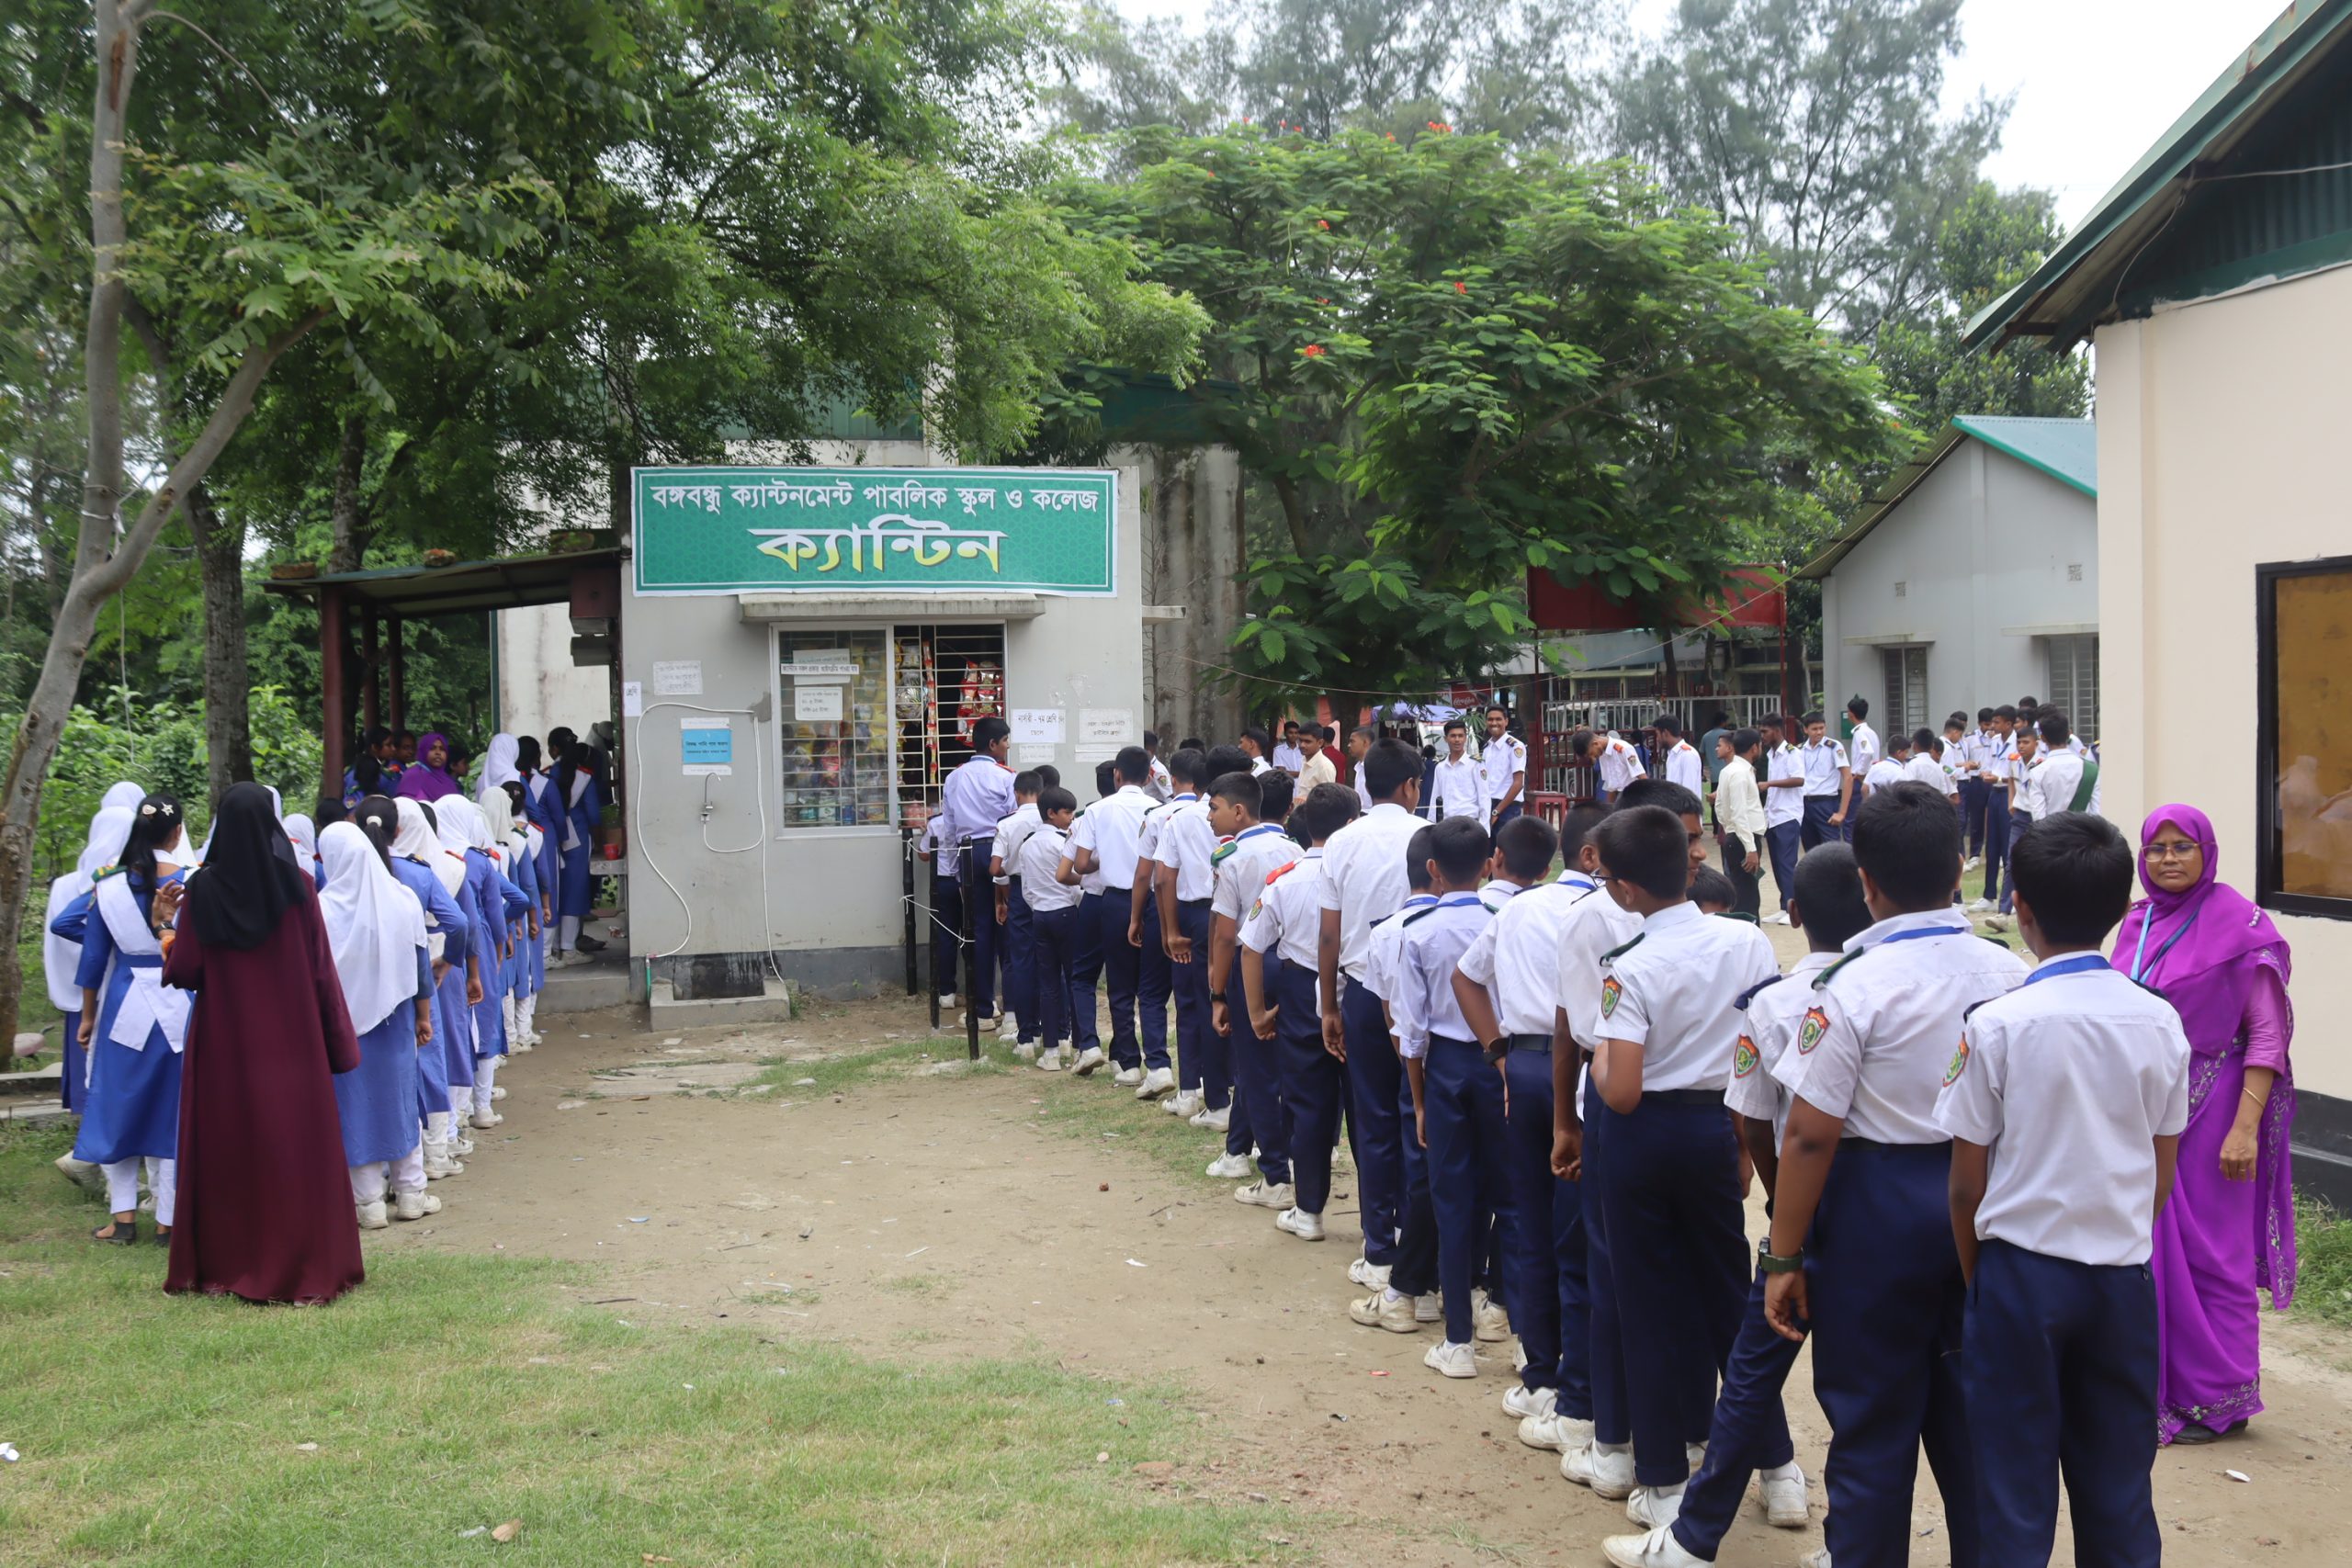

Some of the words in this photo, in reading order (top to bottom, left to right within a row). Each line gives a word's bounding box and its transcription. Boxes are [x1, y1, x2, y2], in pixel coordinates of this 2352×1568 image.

[650, 485, 723, 514] বঙ্গবন্ধু
[729, 478, 854, 509] ক্যান্টনমেন্ট
[863, 479, 948, 509] পাবলিক
[955, 487, 997, 516] স্কুল
[1005, 490, 1023, 508] ও
[1029, 489, 1099, 513] কলেজ
[746, 513, 1009, 574] ক্যান্টিন
